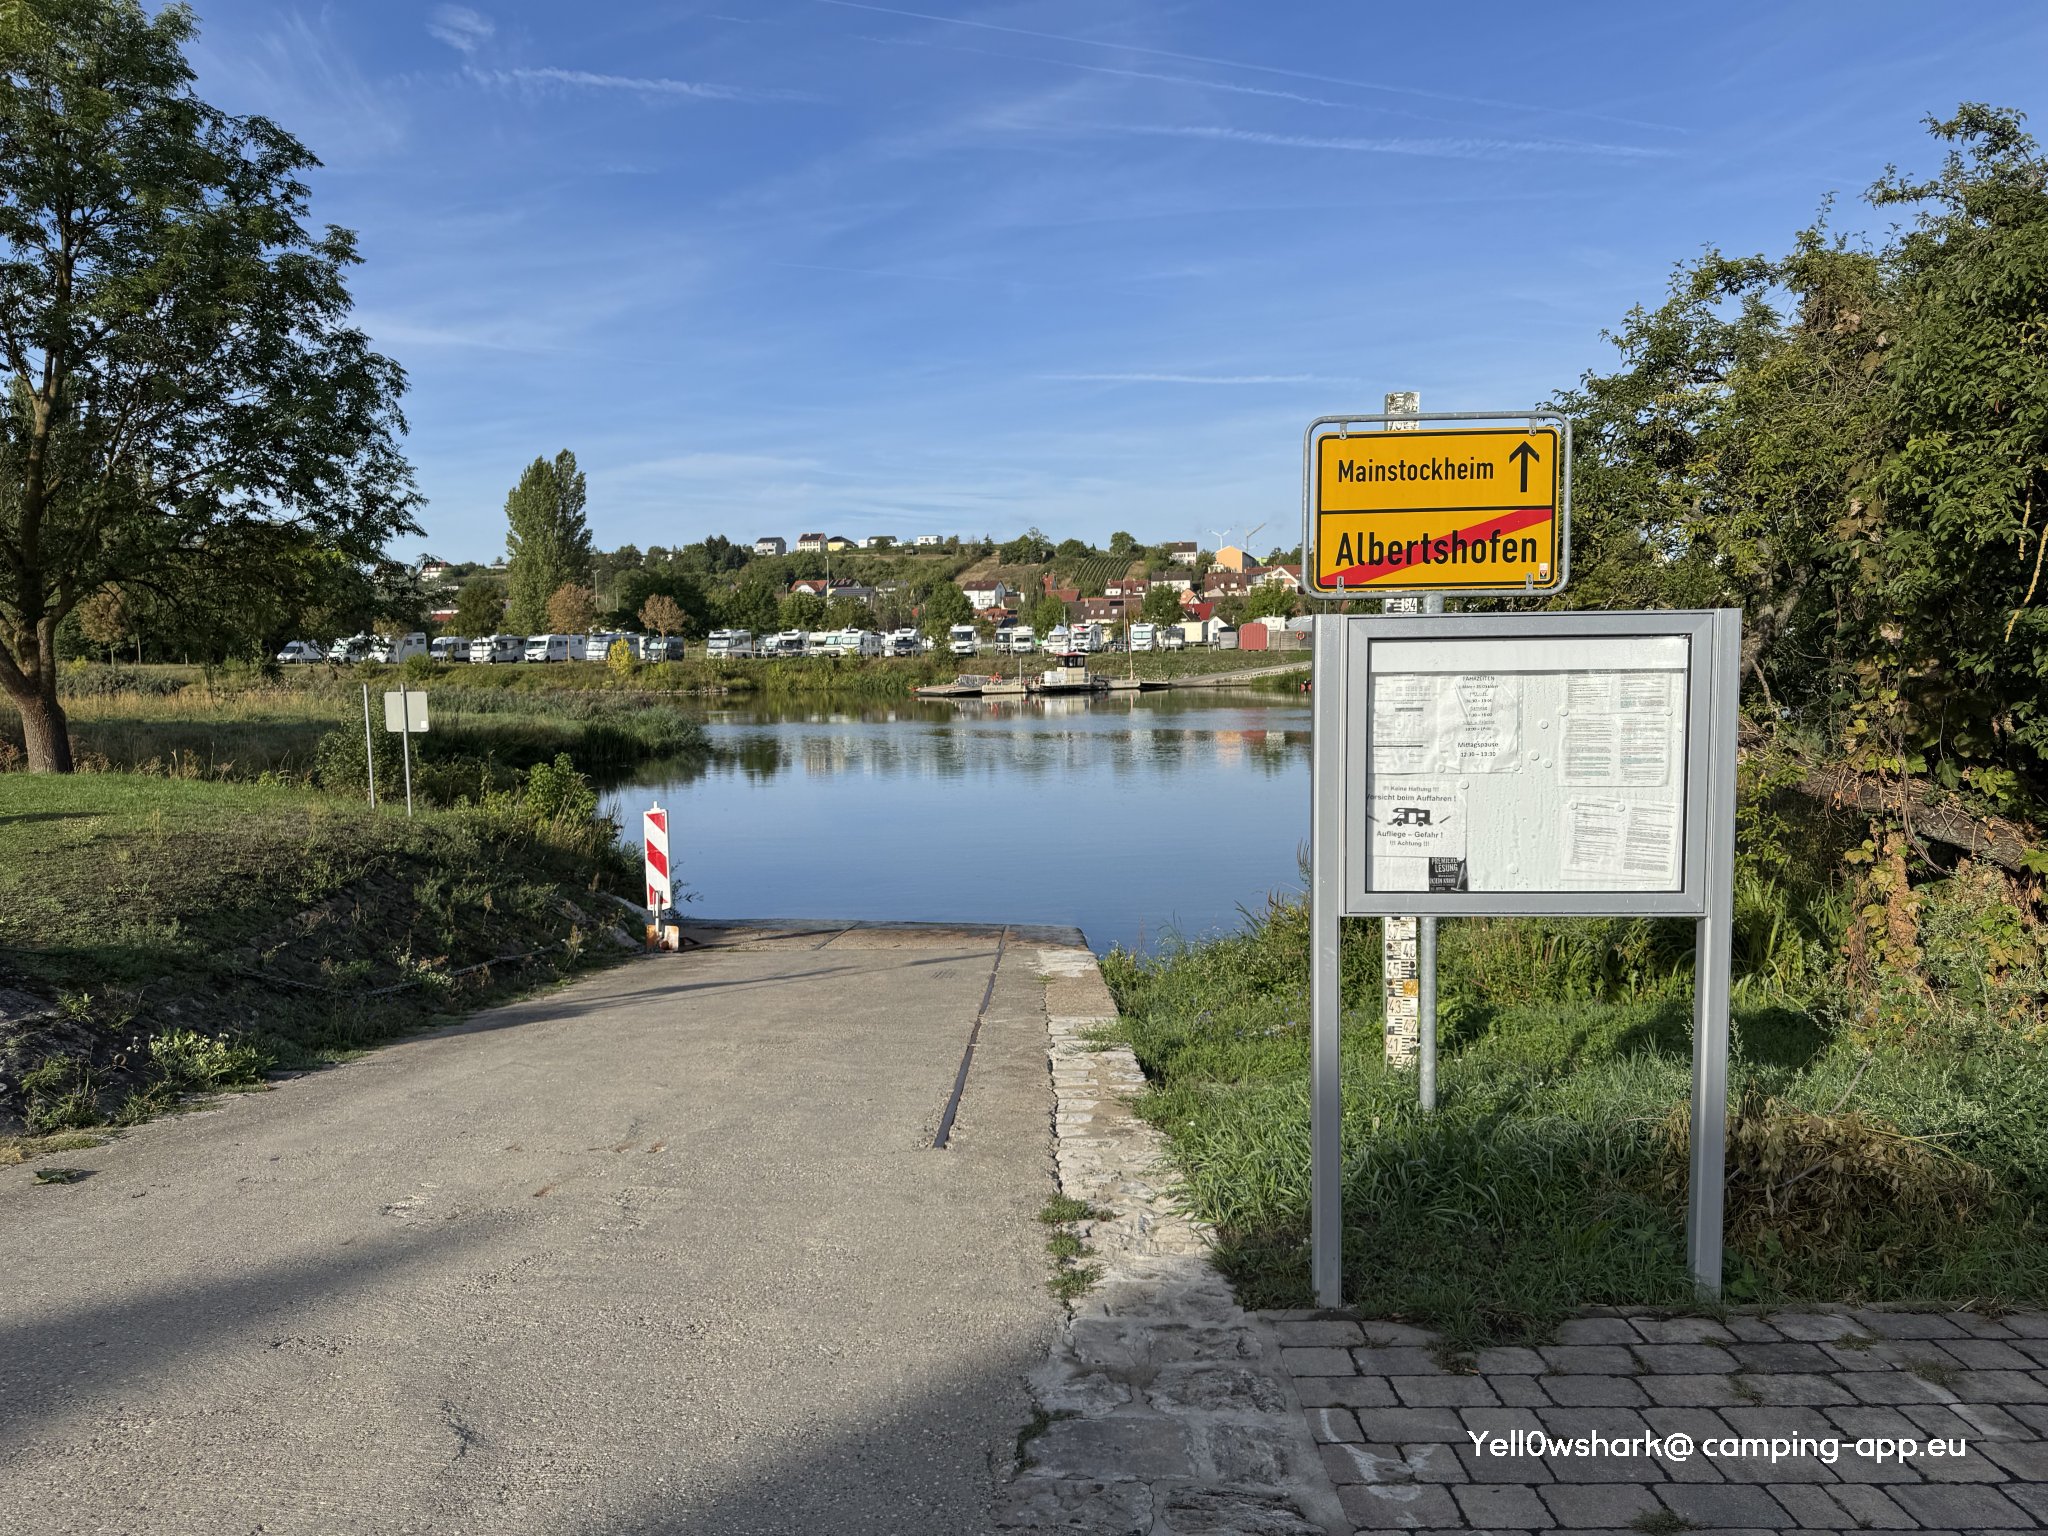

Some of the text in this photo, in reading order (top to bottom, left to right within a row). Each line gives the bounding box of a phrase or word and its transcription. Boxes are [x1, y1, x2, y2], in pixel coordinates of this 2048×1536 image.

[1338, 456, 1494, 483] Mainstockheim
[1335, 529, 1537, 567] Albertshofen
[1457, 741, 1499, 749] Mittagspause
[1376, 830, 1407, 839] Aufliege
[1431, 857, 1461, 865] PREMIERE
[1435, 863, 1459, 873] LESUNG
